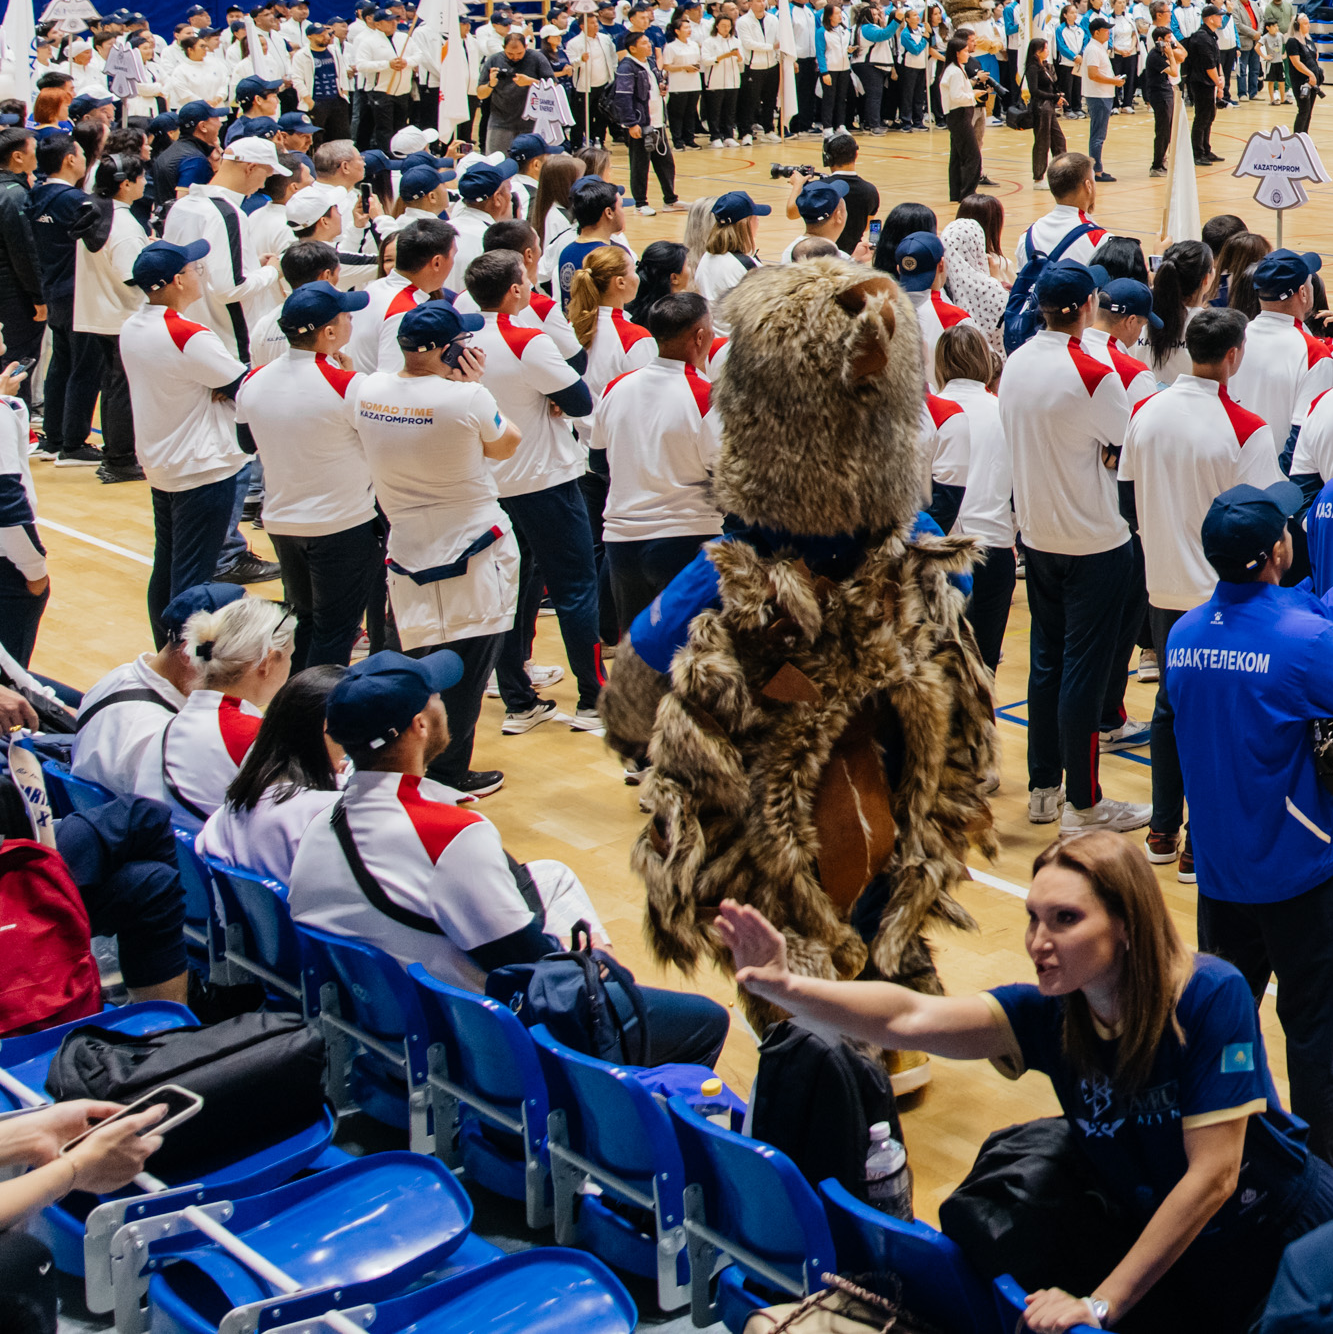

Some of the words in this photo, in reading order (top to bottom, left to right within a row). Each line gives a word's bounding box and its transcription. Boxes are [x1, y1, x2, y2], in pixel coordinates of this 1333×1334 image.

[1253, 163, 1300, 173] KAZATOMPROM
[360, 400, 399, 415] NOMAD
[403, 407, 434, 417] TIME
[360, 409, 434, 425] KAZATOMPROM
[1168, 647, 1271, 674] ҚАЗАҚТЕЛЕКОМ
